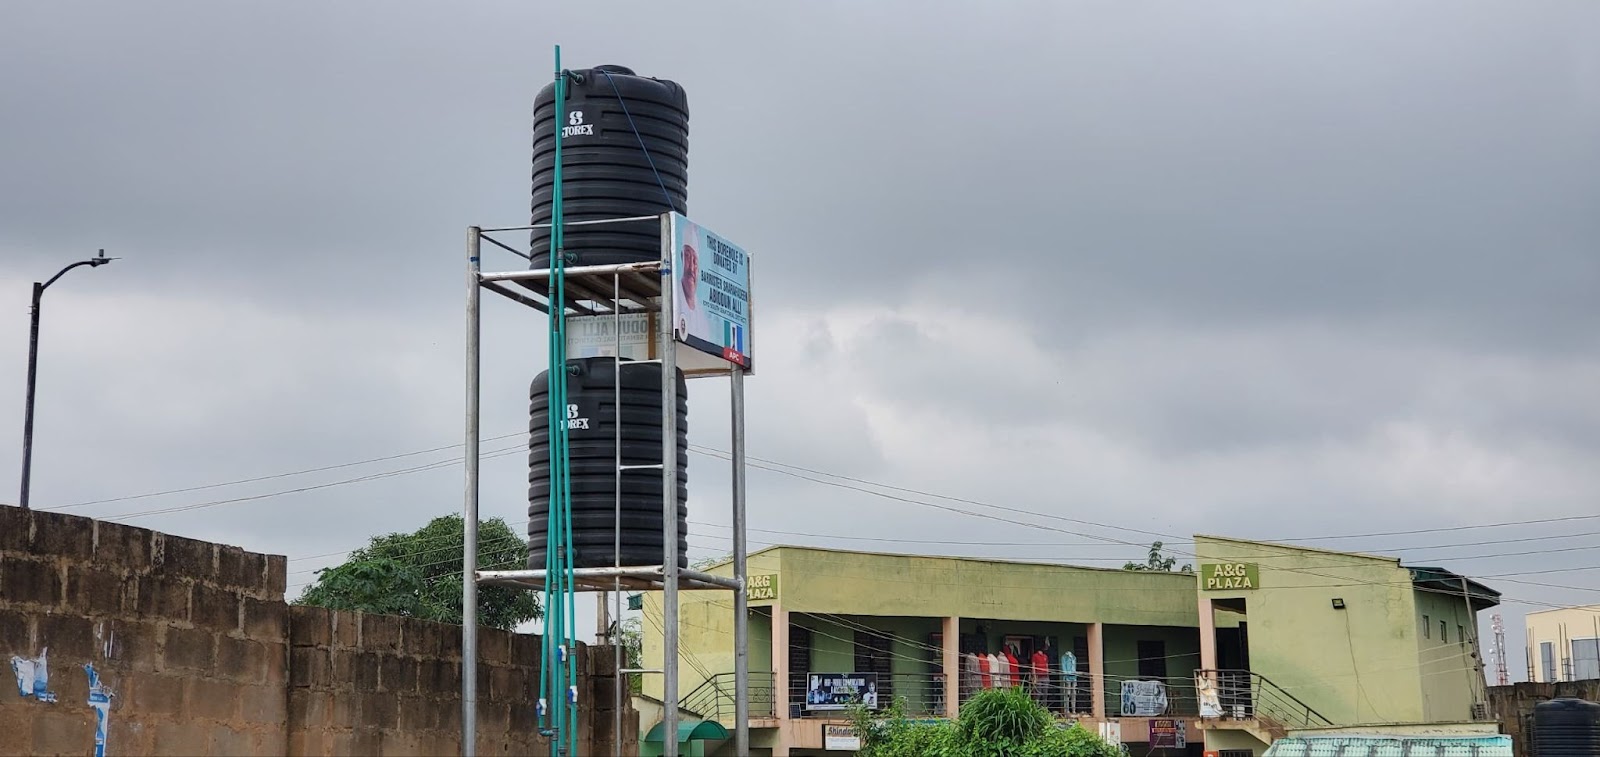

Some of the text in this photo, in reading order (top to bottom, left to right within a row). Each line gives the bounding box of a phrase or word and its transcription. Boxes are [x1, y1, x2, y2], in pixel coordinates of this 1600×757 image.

[706, 235, 716, 251] THIS
[717, 240, 739, 264] BOREHOLE
[713, 252, 731, 271] DONATED
[701, 269, 722, 290] BARRISTER
[729, 351, 740, 362] APC
[1213, 563, 1246, 577] A&G
[747, 575, 771, 588] A&G
[1207, 577, 1252, 589] PLAZA
